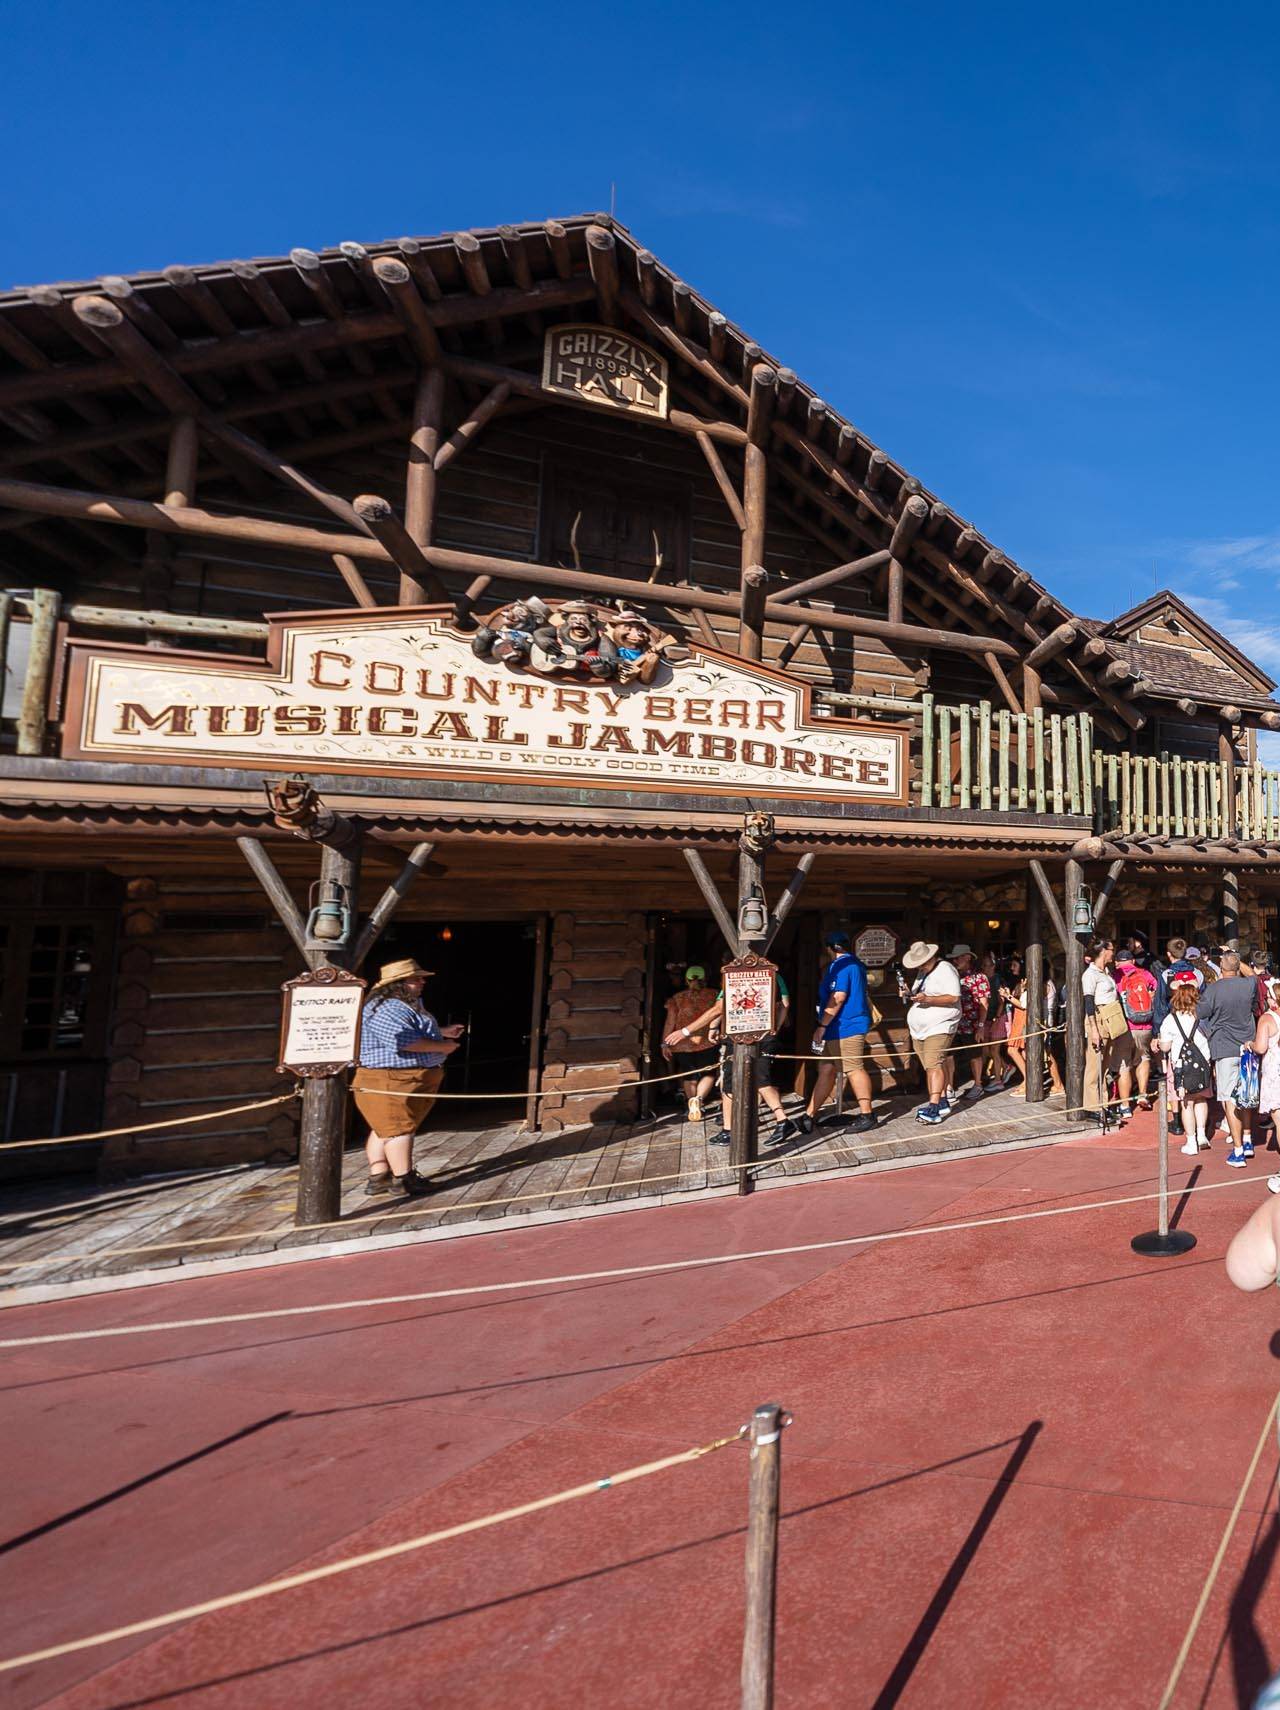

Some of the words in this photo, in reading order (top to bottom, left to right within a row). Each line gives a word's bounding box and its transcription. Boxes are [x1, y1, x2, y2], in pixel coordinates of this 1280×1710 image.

[558, 333, 656, 375] GRIZZLY
[587, 356, 628, 376] 1898
[556, 362, 655, 407] HALL
[308, 648, 630, 717] COUNTRY
[643, 695, 787, 733] BEAR
[112, 701, 529, 746] MUSICAL
[547, 721, 890, 787] JAMBOREE
[397, 745, 417, 755] A
[425, 746, 495, 760] WILD
[519, 752, 601, 768] WOOLY
[606, 759, 664, 772] GOOD
[668, 763, 720, 776] TIME
